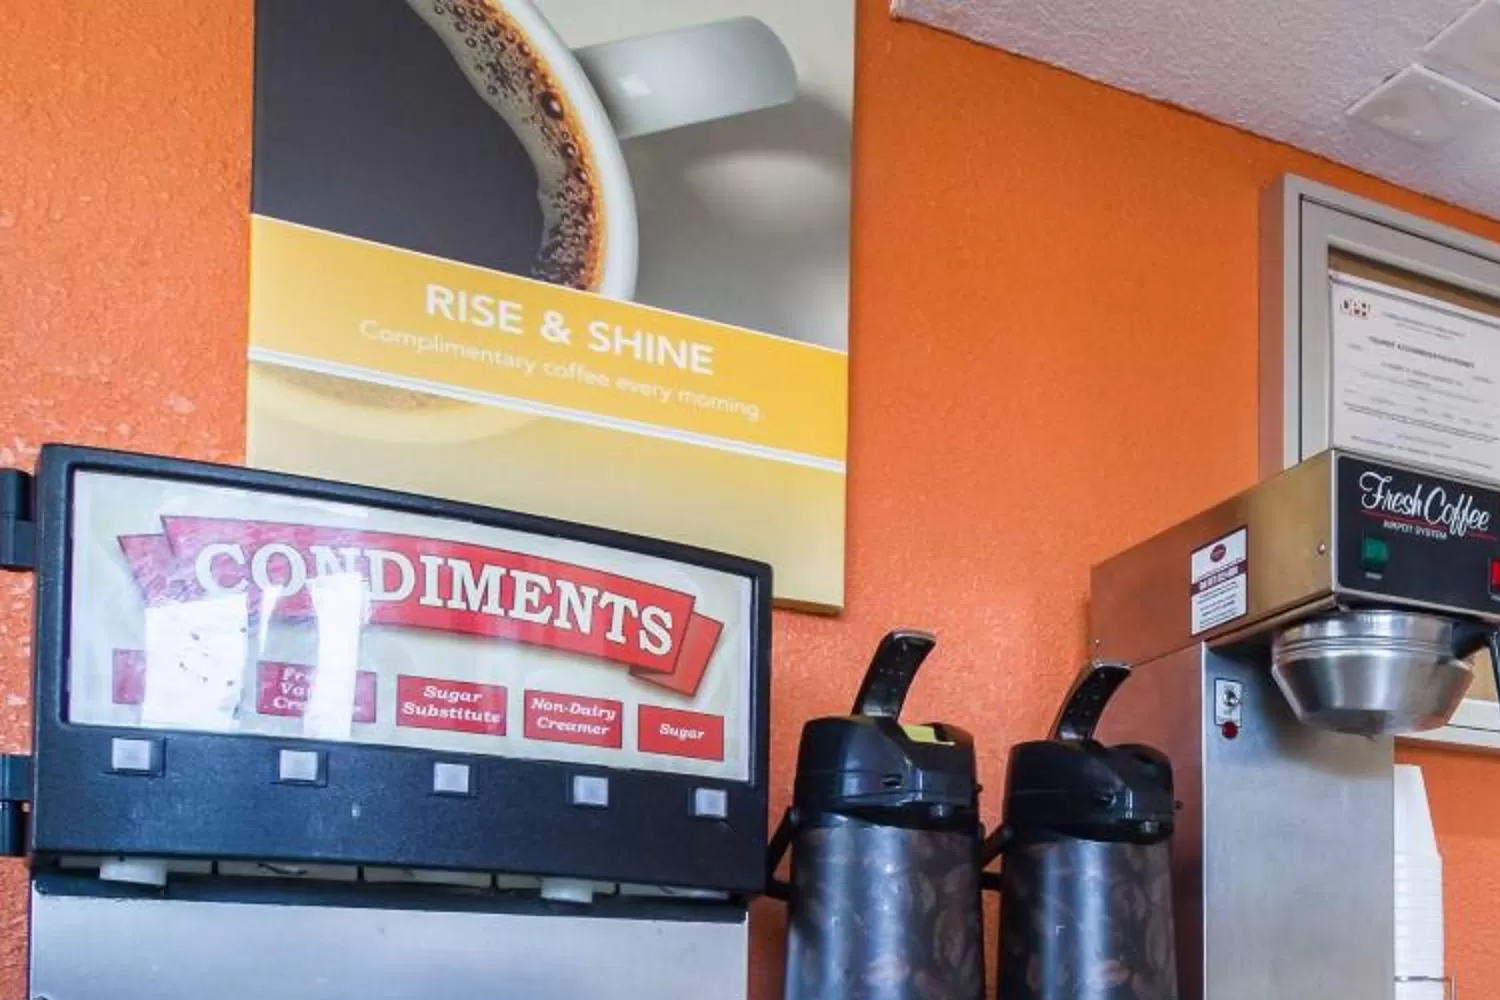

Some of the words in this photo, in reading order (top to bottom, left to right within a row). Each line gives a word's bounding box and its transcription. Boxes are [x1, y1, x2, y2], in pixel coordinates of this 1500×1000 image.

[425, 284, 523, 336] RISE
[540, 310, 573, 345] &
[588, 322, 715, 376] SHINE
[360, 319, 536, 377] Complimentary
[543, 361, 609, 387] coffee
[616, 377, 672, 404] every
[1359, 471, 1423, 518] Fresh
[1424, 486, 1491, 537] Coffee
[195, 542, 674, 657] CONDIMENTS
[423, 684, 483, 704] Sugar
[402, 701, 501, 724] Substitute
[530, 697, 617, 722] Non-Dairy
[536, 716, 610, 736] Creamer
[658, 722, 706, 741] Sugar
